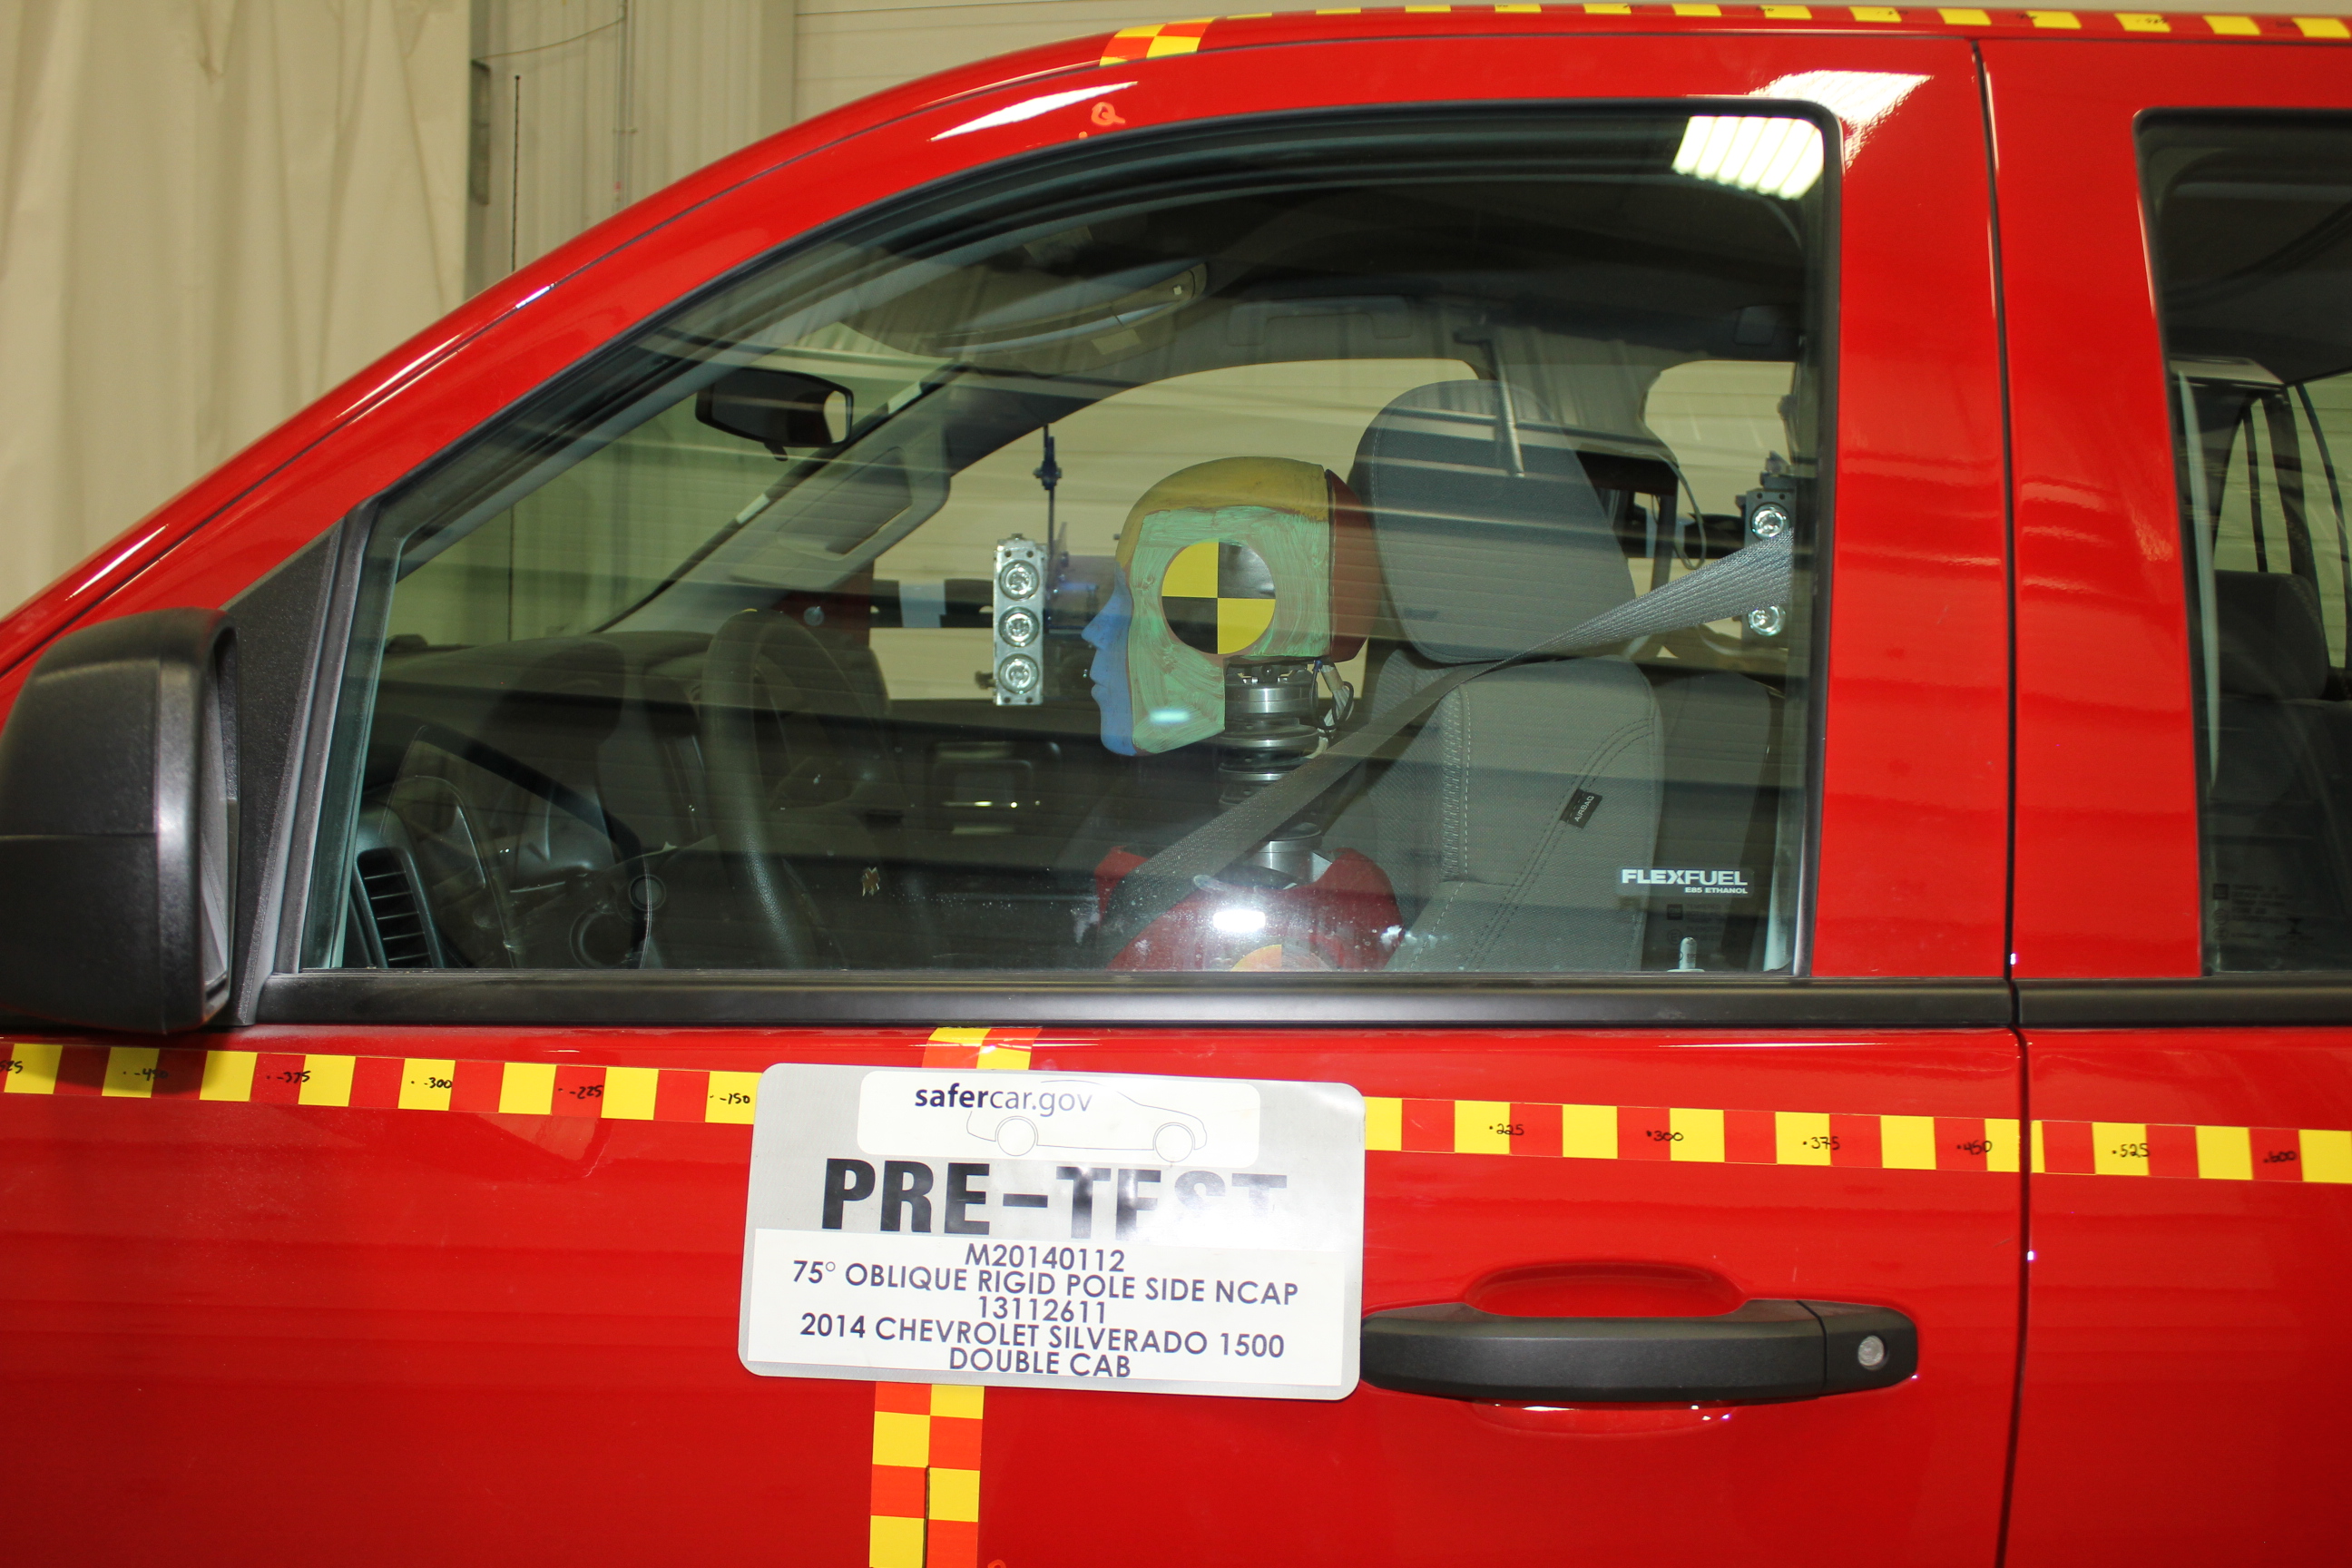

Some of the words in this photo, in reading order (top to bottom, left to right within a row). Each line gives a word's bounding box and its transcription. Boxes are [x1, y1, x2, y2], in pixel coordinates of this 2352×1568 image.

[1574, 795, 1595, 822] AIRBAG
[1621, 868, 1749, 887] FLEXFUEL
[1705, 887, 1749, 895] ETHANOL
[423, 1076, 453, 1089] -300
[720, 1093, 751, 1105] -150
[914, 1083, 1093, 1117] safercar.gov
[964, 1242, 1126, 1273] M20140112
[845, 1262, 968, 1292] OBLIQUE
[977, 1269, 1055, 1296] RIGID
[1066, 1273, 1136, 1299] POLE
[1144, 1276, 1206, 1302] SIDE
[1215, 1279, 1298, 1306] NCAP
[977, 1295, 1105, 1325] 13112611
[799, 1312, 867, 1338] 2014
[875, 1316, 1040, 1348] CHEVROLET
[1048, 1324, 1209, 1356] SILVERADO
[1220, 1332, 1285, 1358] 1500
[949, 1347, 1060, 1375] DOUBLE
[1069, 1352, 1132, 1378] CAB
